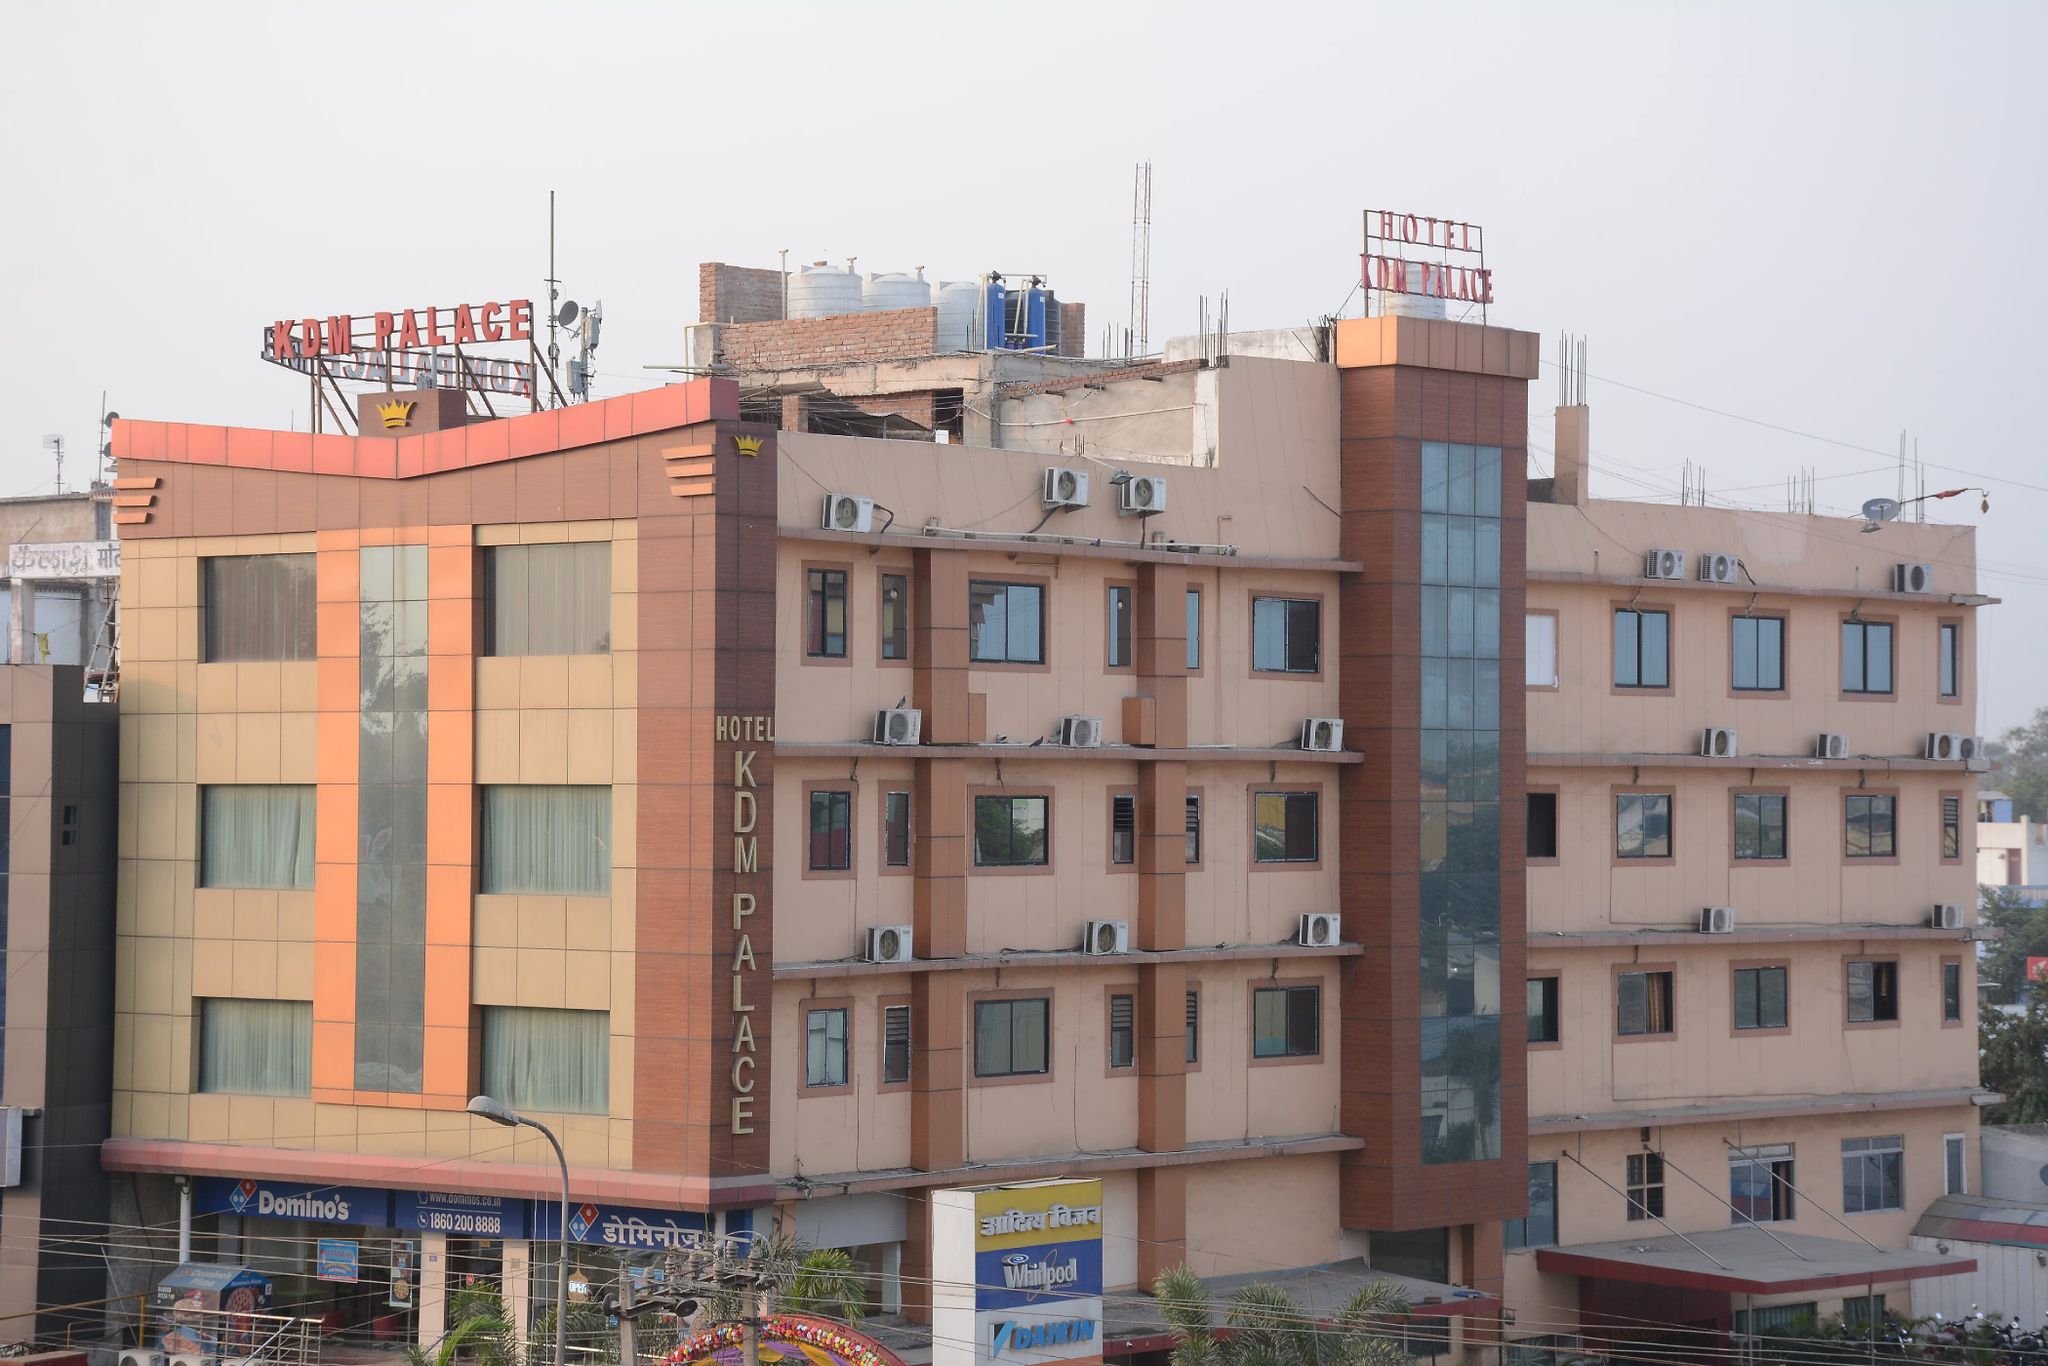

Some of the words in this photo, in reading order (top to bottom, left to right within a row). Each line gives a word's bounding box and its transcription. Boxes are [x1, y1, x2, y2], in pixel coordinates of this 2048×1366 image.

[1380, 210, 1473, 252] HOTEL
[1360, 253, 1408, 294] KDM
[1421, 261, 1493, 304] PALACE
[274, 314, 352, 360] KDM
[374, 299, 529, 351] PALACE
[716, 715, 775, 741] HOTEL
[734, 751, 757, 873] KDM
[731, 893, 757, 1135] PALACE
[259, 1190, 349, 1220] Domino's
[429, 1192, 501, 1207] www.dominos.co.in
[430, 1212, 453, 1230] 1860
[454, 1214, 474, 1232] 200
[475, 1216, 501, 1233] 8888
[1003, 1258, 1077, 1292] Whirlpool
[1012, 1318, 1096, 1351] DAIKIN
